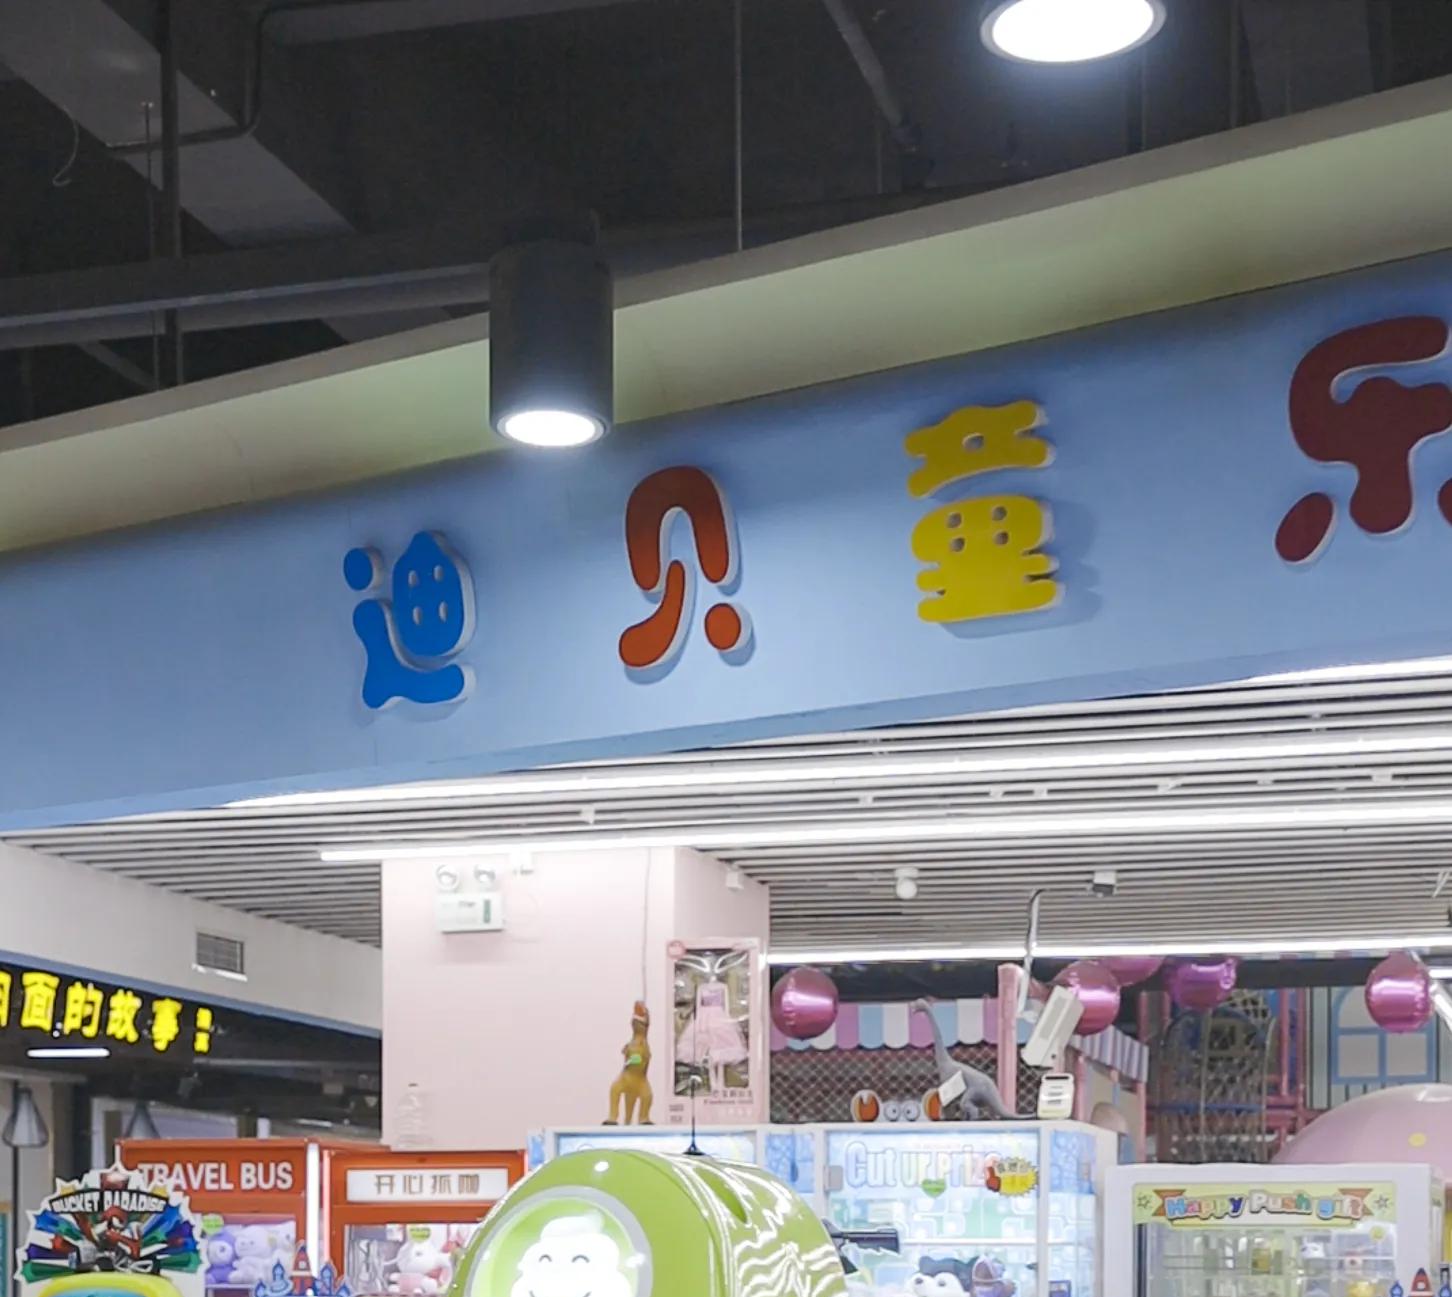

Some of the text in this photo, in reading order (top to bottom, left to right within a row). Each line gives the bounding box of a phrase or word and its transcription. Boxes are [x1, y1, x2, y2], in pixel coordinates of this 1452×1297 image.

[138, 1162, 293, 1190] TRAVEL BUS
[846, 1140, 896, 1188] Cut
[52, 1192, 99, 1213] BUCKET
[1165, 1195, 1246, 1219] Happy
[1250, 1190, 1312, 1214] Push
